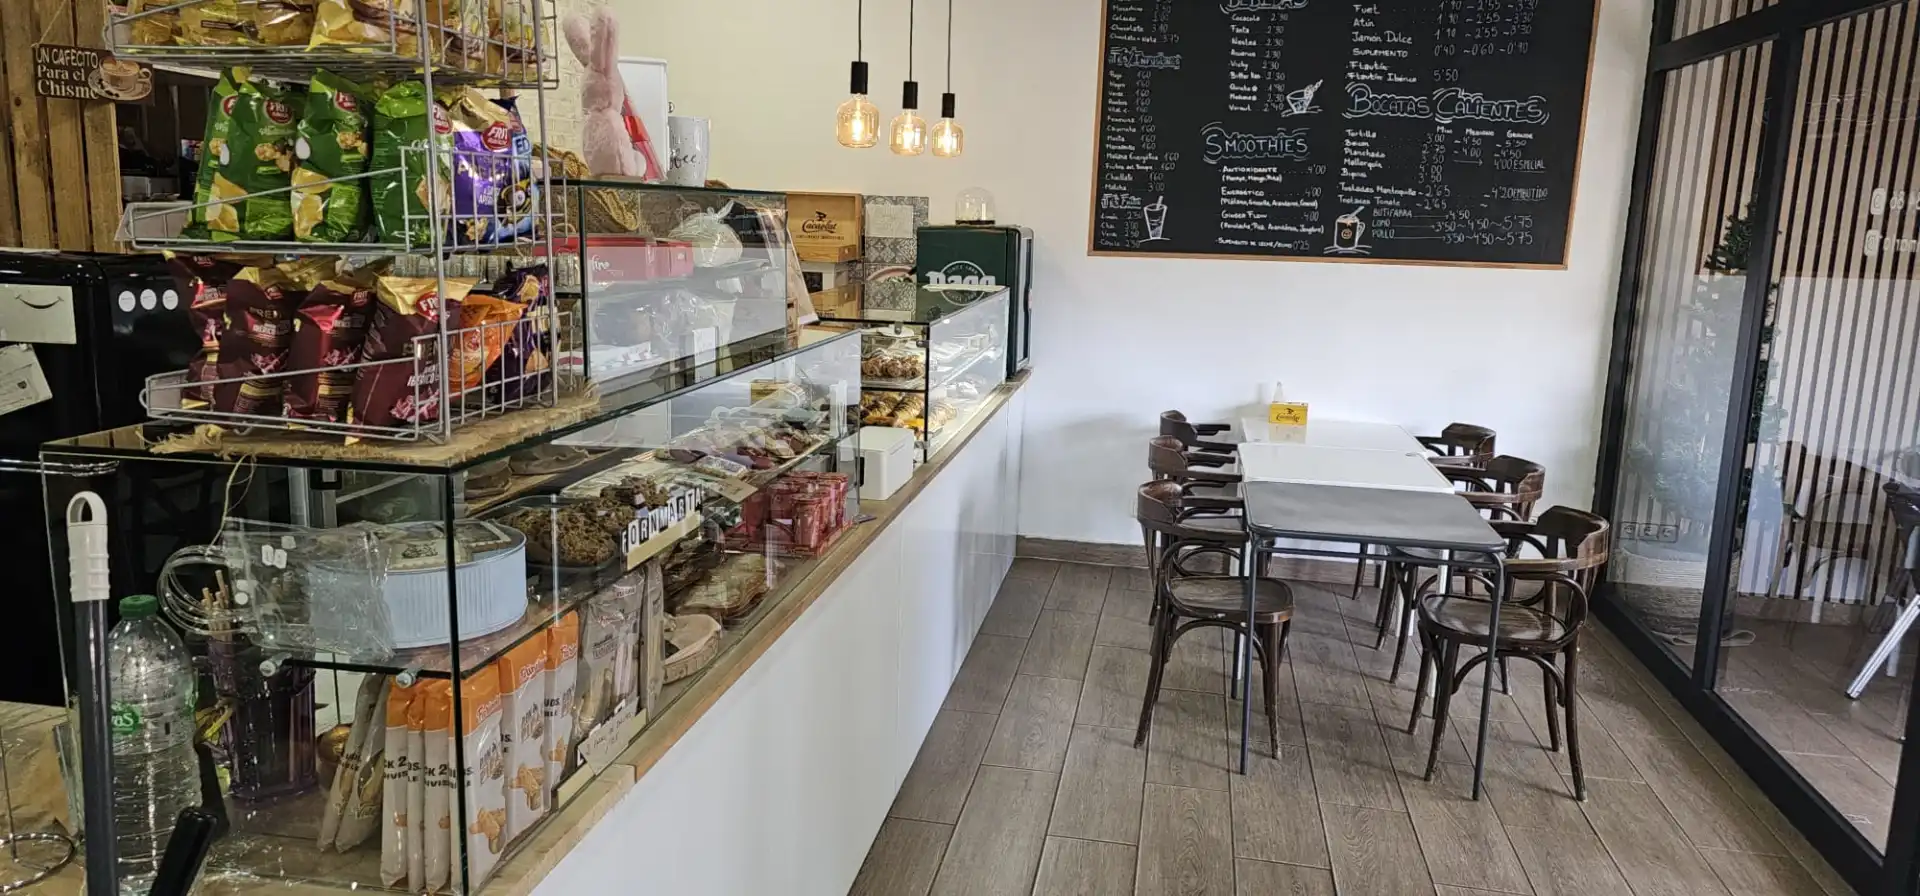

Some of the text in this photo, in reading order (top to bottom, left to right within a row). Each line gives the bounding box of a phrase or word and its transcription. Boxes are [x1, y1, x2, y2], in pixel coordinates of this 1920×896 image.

[1352, 4, 1380, 14] Fuet
[1383, 30, 1413, 44] Dulce
[36, 47, 99, 69] UN CAFECITO
[1352, 47, 1409, 58] SUPLEMENTO
[37, 64, 86, 81] Para el
[1433, 68, 1460, 82] 5'50
[37, 80, 99, 99] Chisme
[1347, 87, 1543, 119] BOCATAS CALIENTES
[1205, 134, 1309, 155] SMOOTHIES
[801, 219, 838, 234] Cacaolat
